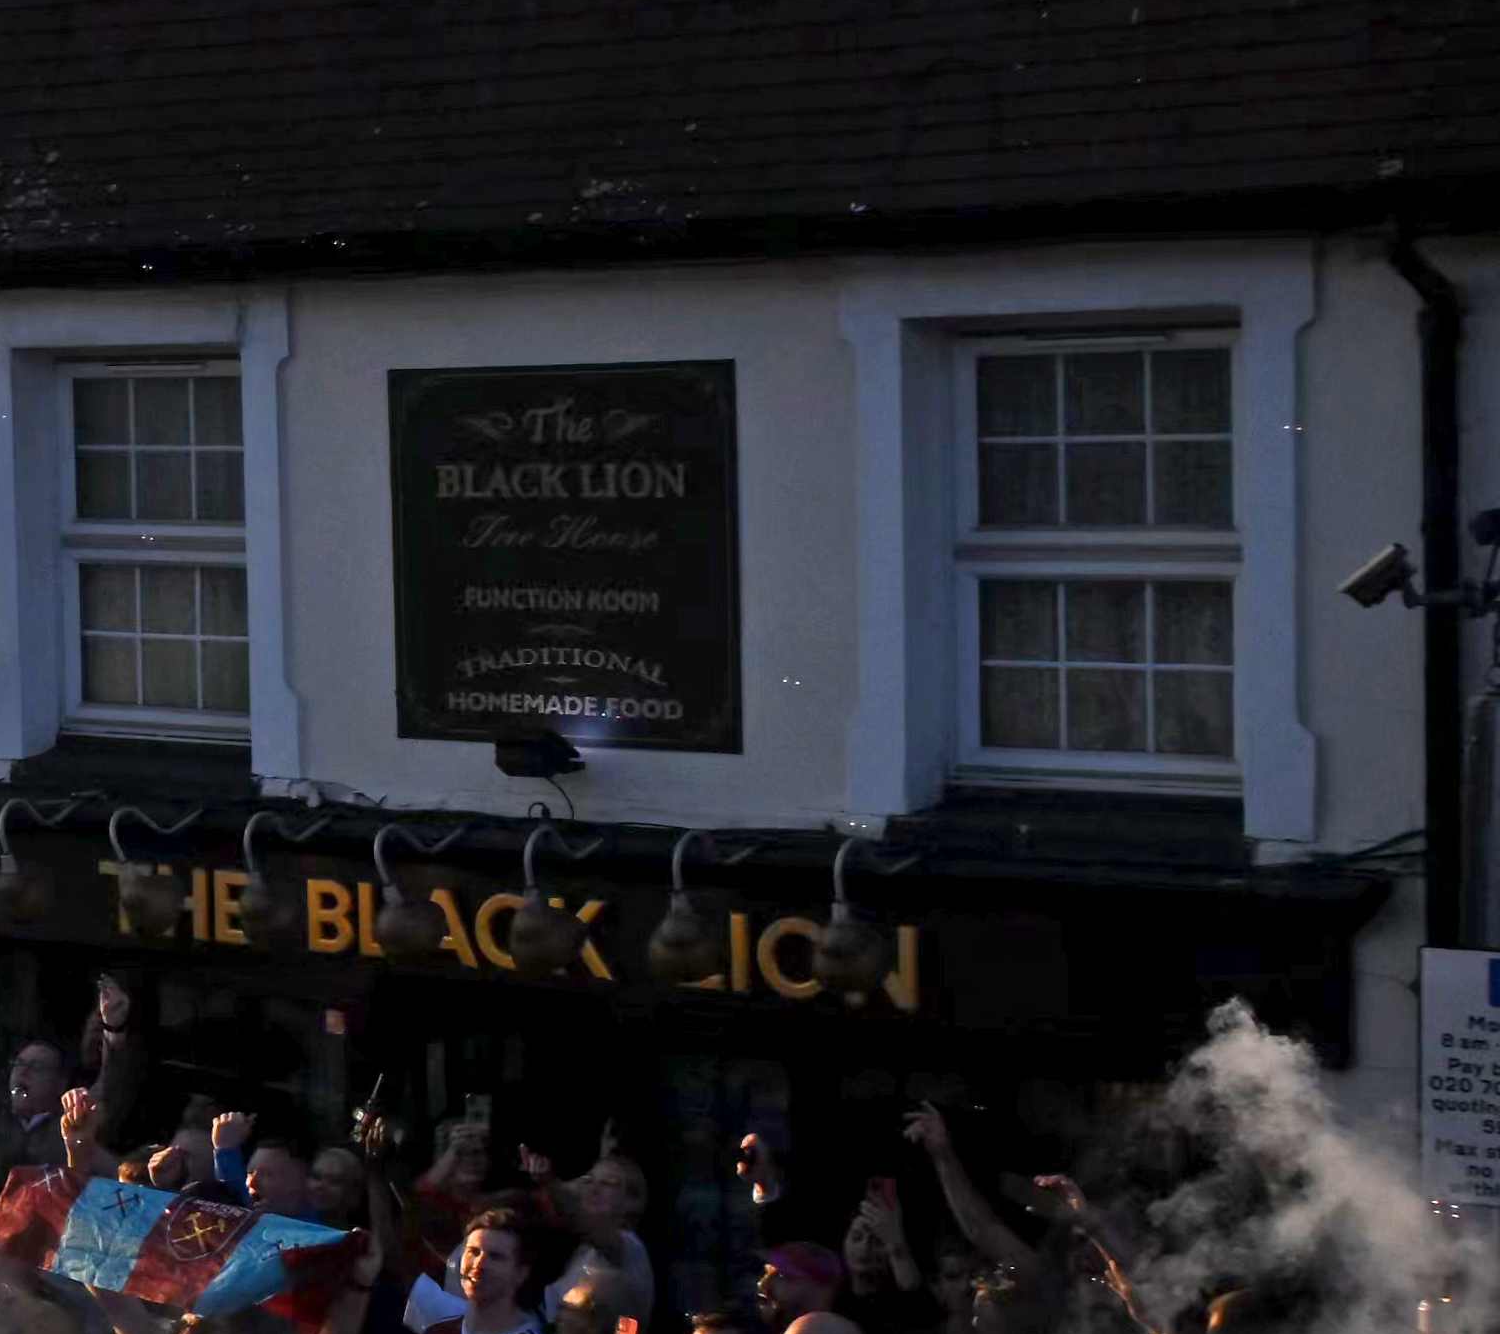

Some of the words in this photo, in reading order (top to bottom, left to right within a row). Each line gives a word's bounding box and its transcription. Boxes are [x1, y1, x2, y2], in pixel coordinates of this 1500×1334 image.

[520, 396, 595, 444] The
[435, 464, 568, 499] BLACK
[580, 462, 687, 499] LION
[543, 513, 660, 551] House
[463, 586, 581, 612] FUNCTION
[587, 587, 660, 614] ROOM
[456, 646, 669, 687] TRADITIONAL
[447, 691, 597, 717] HOMEMADE
[604, 697, 684, 721] FOOD
[1429, 1075, 1471, 1093] 020
[1447, 1057, 1484, 1078] Pay
